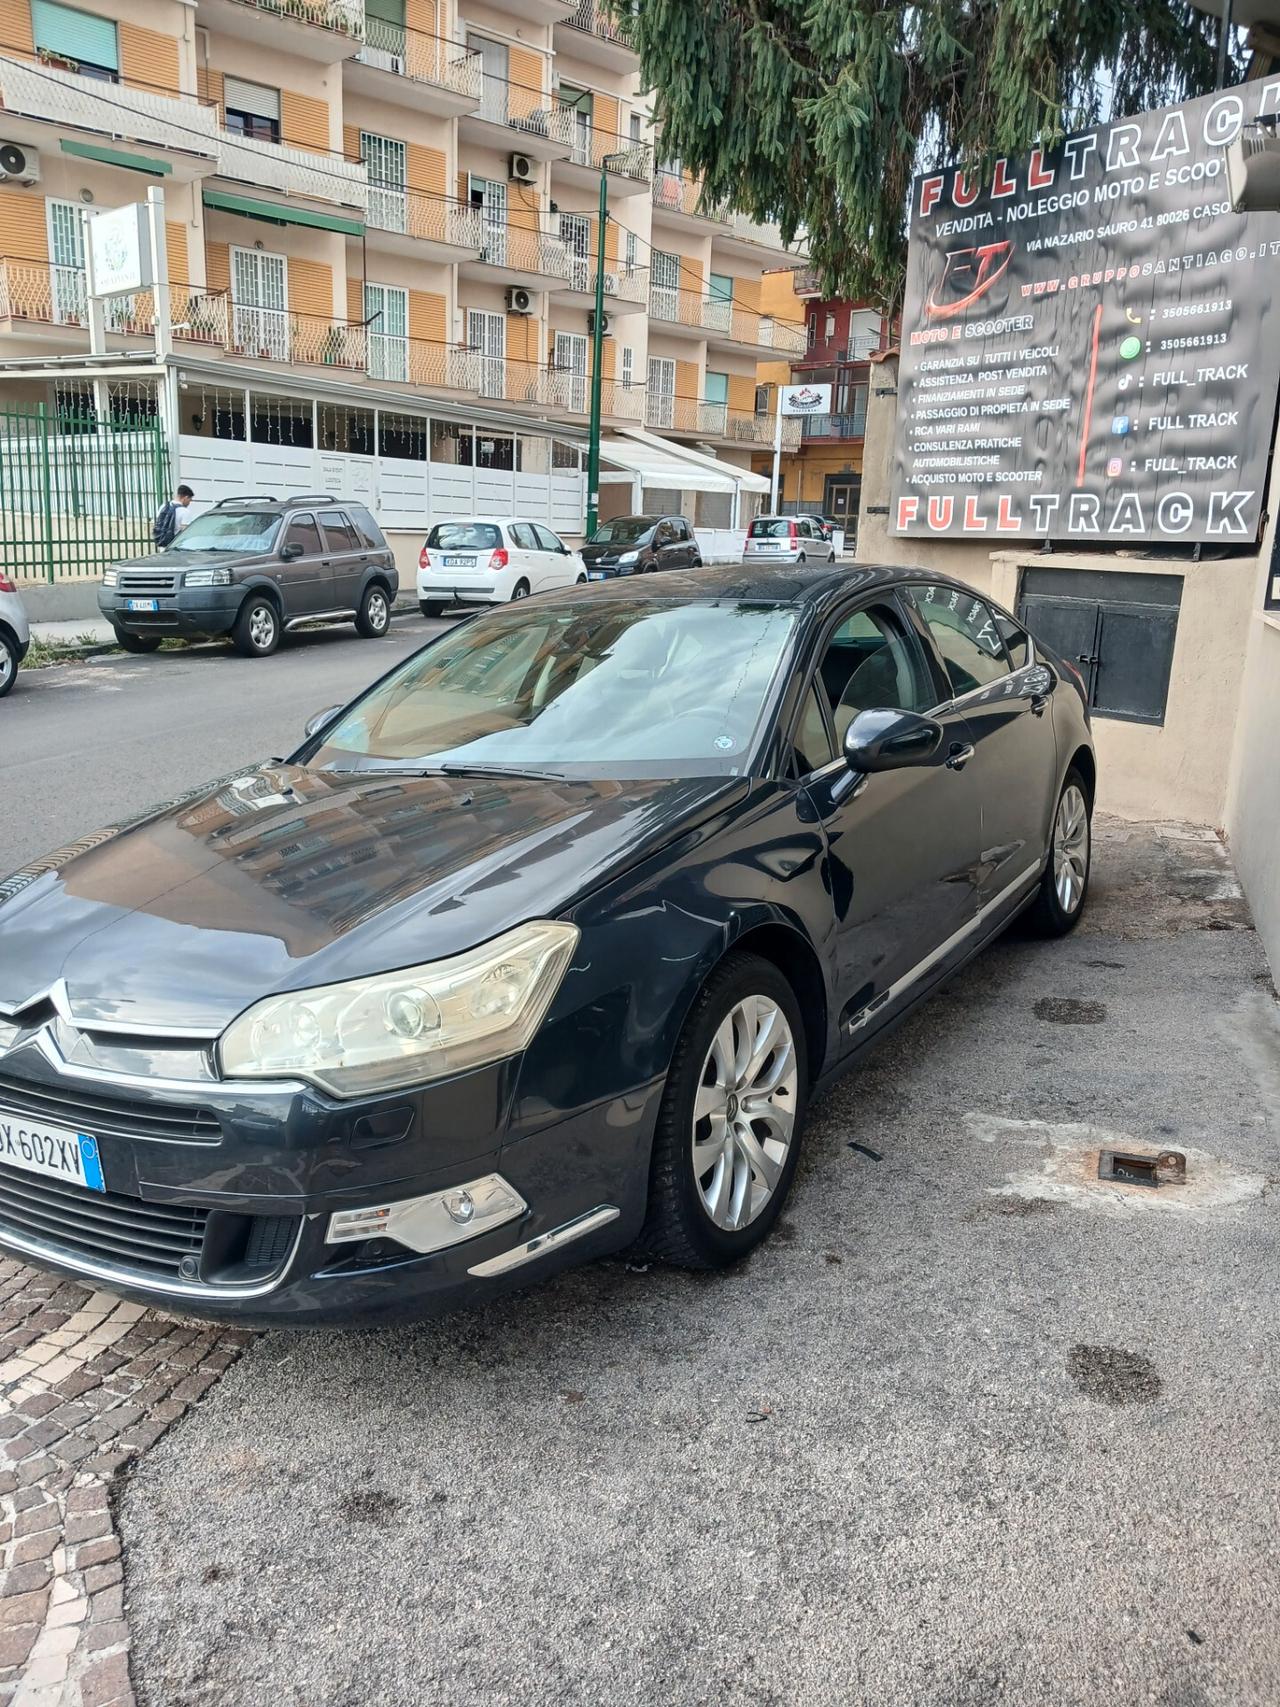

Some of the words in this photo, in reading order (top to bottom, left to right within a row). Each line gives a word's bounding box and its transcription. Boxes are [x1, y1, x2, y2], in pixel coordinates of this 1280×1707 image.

[936, 211, 993, 237] VENDITA
[1006, 190, 1089, 223] NOLEGGIO
[1094, 176, 1144, 203] MOTO
[1148, 172, 1160, 191] E
[1026, 240, 1041, 252] VIA
[1044, 229, 1094, 249] NAZARIO
[1097, 219, 1137, 239] SAURO
[1140, 217, 1153, 229] 41
[1157, 209, 1189, 227] 80026
[1193, 201, 1231, 219] CASO
[1021, 240, 1280, 297] WWW.GRUPPOSANTIAGO.IT
[910, 327, 948, 345] MOTO
[952, 325, 961, 339] E
[965, 315, 1033, 338] SCOOTER
[1160, 333, 1227, 350] 3505661913
[920, 356, 964, 371] GARANZIA
[966, 355, 979, 366] SU
[984, 351, 1011, 364] TUTTI
[1013, 351, 1017, 361] I
[1018, 345, 1059, 360] VEICOLI
[919, 373, 974, 388] ASSISTENZA
[978, 370, 1006, 382] POST
[1006, 365, 1047, 379] VENDITA
[1152, 364, 1249, 387] FULL_TRACK
[918, 388, 984, 404] FINANZIAMENTI
[986, 388, 996, 397] IN
[998, 385, 1025, 397] SEDE
[915, 407, 968, 420] PASSAGGIO
[970, 405, 979, 416] DI
[981, 402, 1028, 415] PROPIETA
[1030, 401, 1041, 411] IN
[1042, 398, 1071, 410] SEDE
[914, 425, 933, 436] RCA
[935, 424, 956, 434] VARI
[957, 423, 981, 433] RAMI
[1148, 416, 1184, 431] FULL
[1188, 411, 1239, 427] TRACK
[914, 440, 973, 452] CONSULENZA
[974, 437, 1021, 449] PRATICHE
[912, 455, 1000, 468] AUTOMOBILISTICHE
[1144, 455, 1238, 474] FULL_TRACK
[911, 473, 957, 486] ACQUISTO
[958, 473, 985, 483] MOTO
[986, 472, 993, 481] E
[995, 471, 1042, 481] SCOOTER
